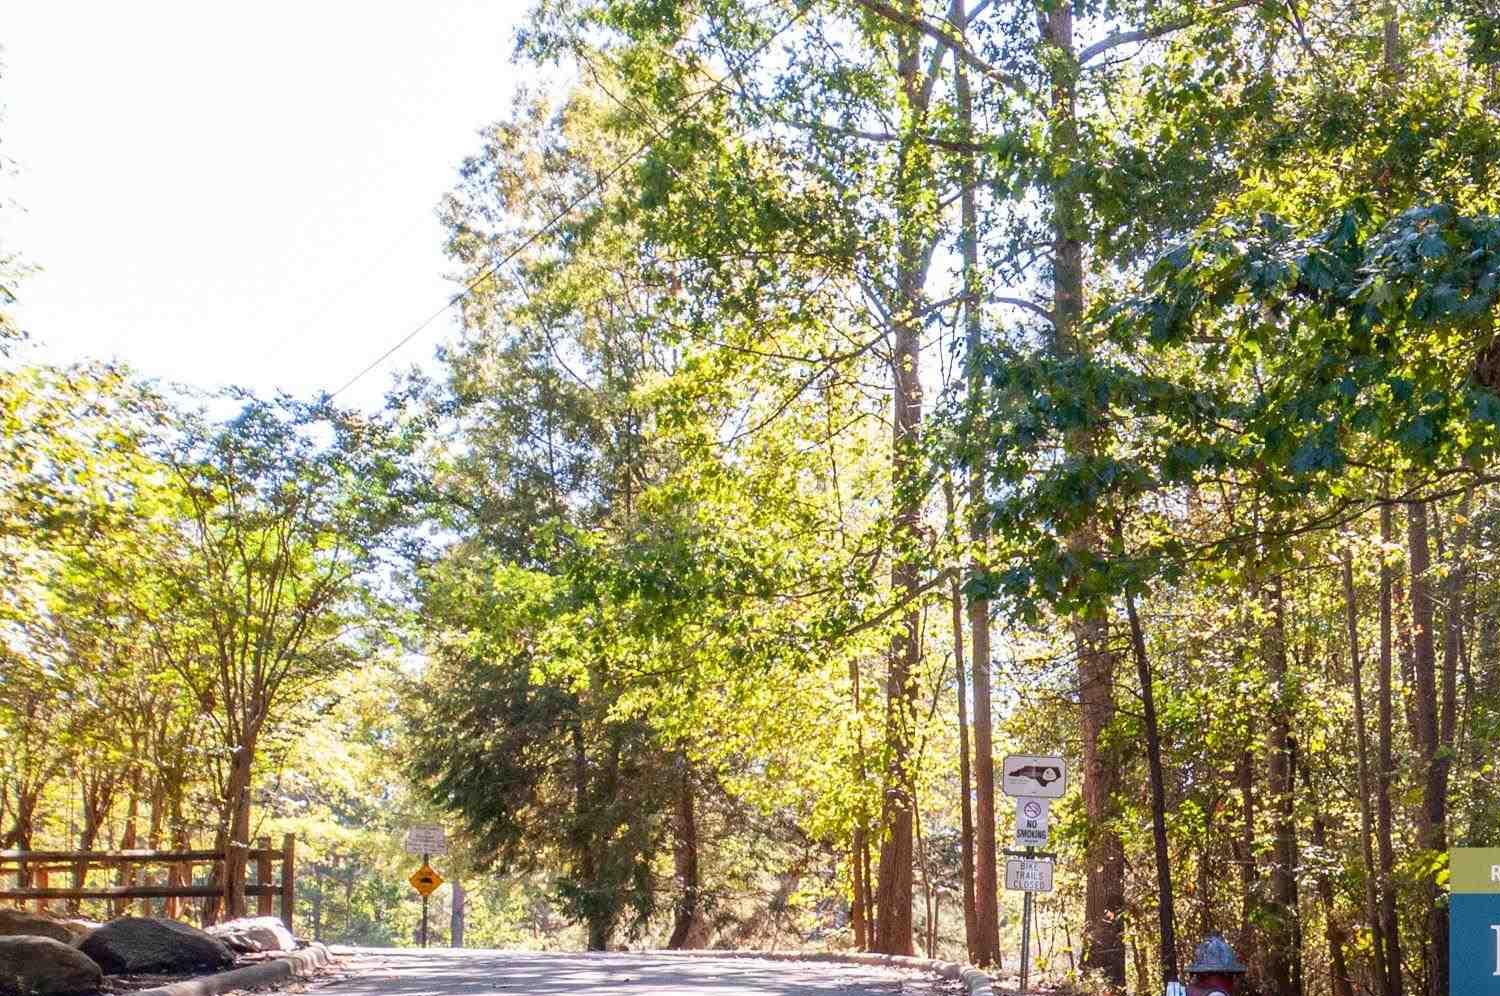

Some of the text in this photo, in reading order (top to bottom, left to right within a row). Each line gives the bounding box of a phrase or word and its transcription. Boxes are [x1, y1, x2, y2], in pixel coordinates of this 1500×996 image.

[1026, 819, 1037, 828] NO
[1016, 829, 1047, 839] SMOKING
[1020, 862, 1039, 871] BIKE
